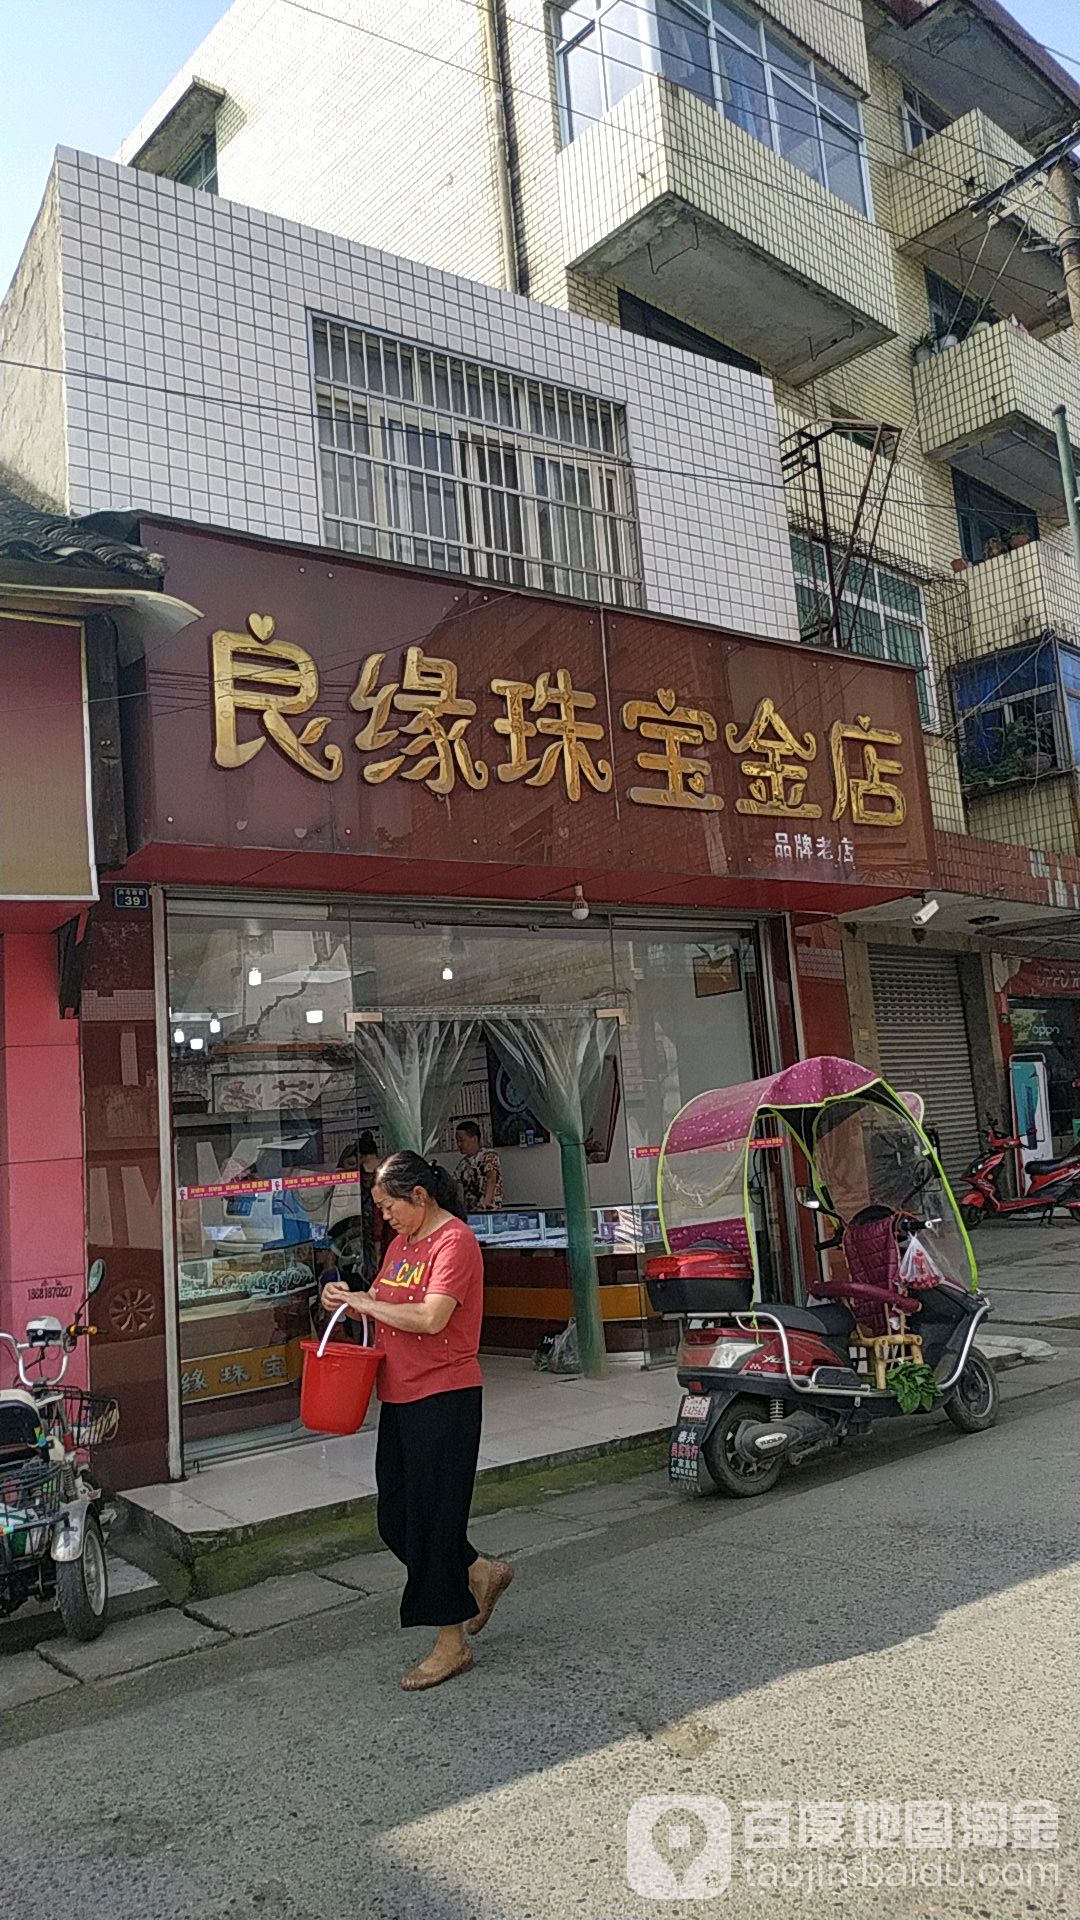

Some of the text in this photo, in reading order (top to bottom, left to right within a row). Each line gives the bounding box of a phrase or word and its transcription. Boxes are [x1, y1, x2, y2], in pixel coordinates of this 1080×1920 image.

[210, 612, 907, 828] 良缘珠宝金店
[775, 832, 855, 863] 品牌老店
[124, 896, 141, 906] 39
[181, 1355, 288, 1394] 缘珠宝
